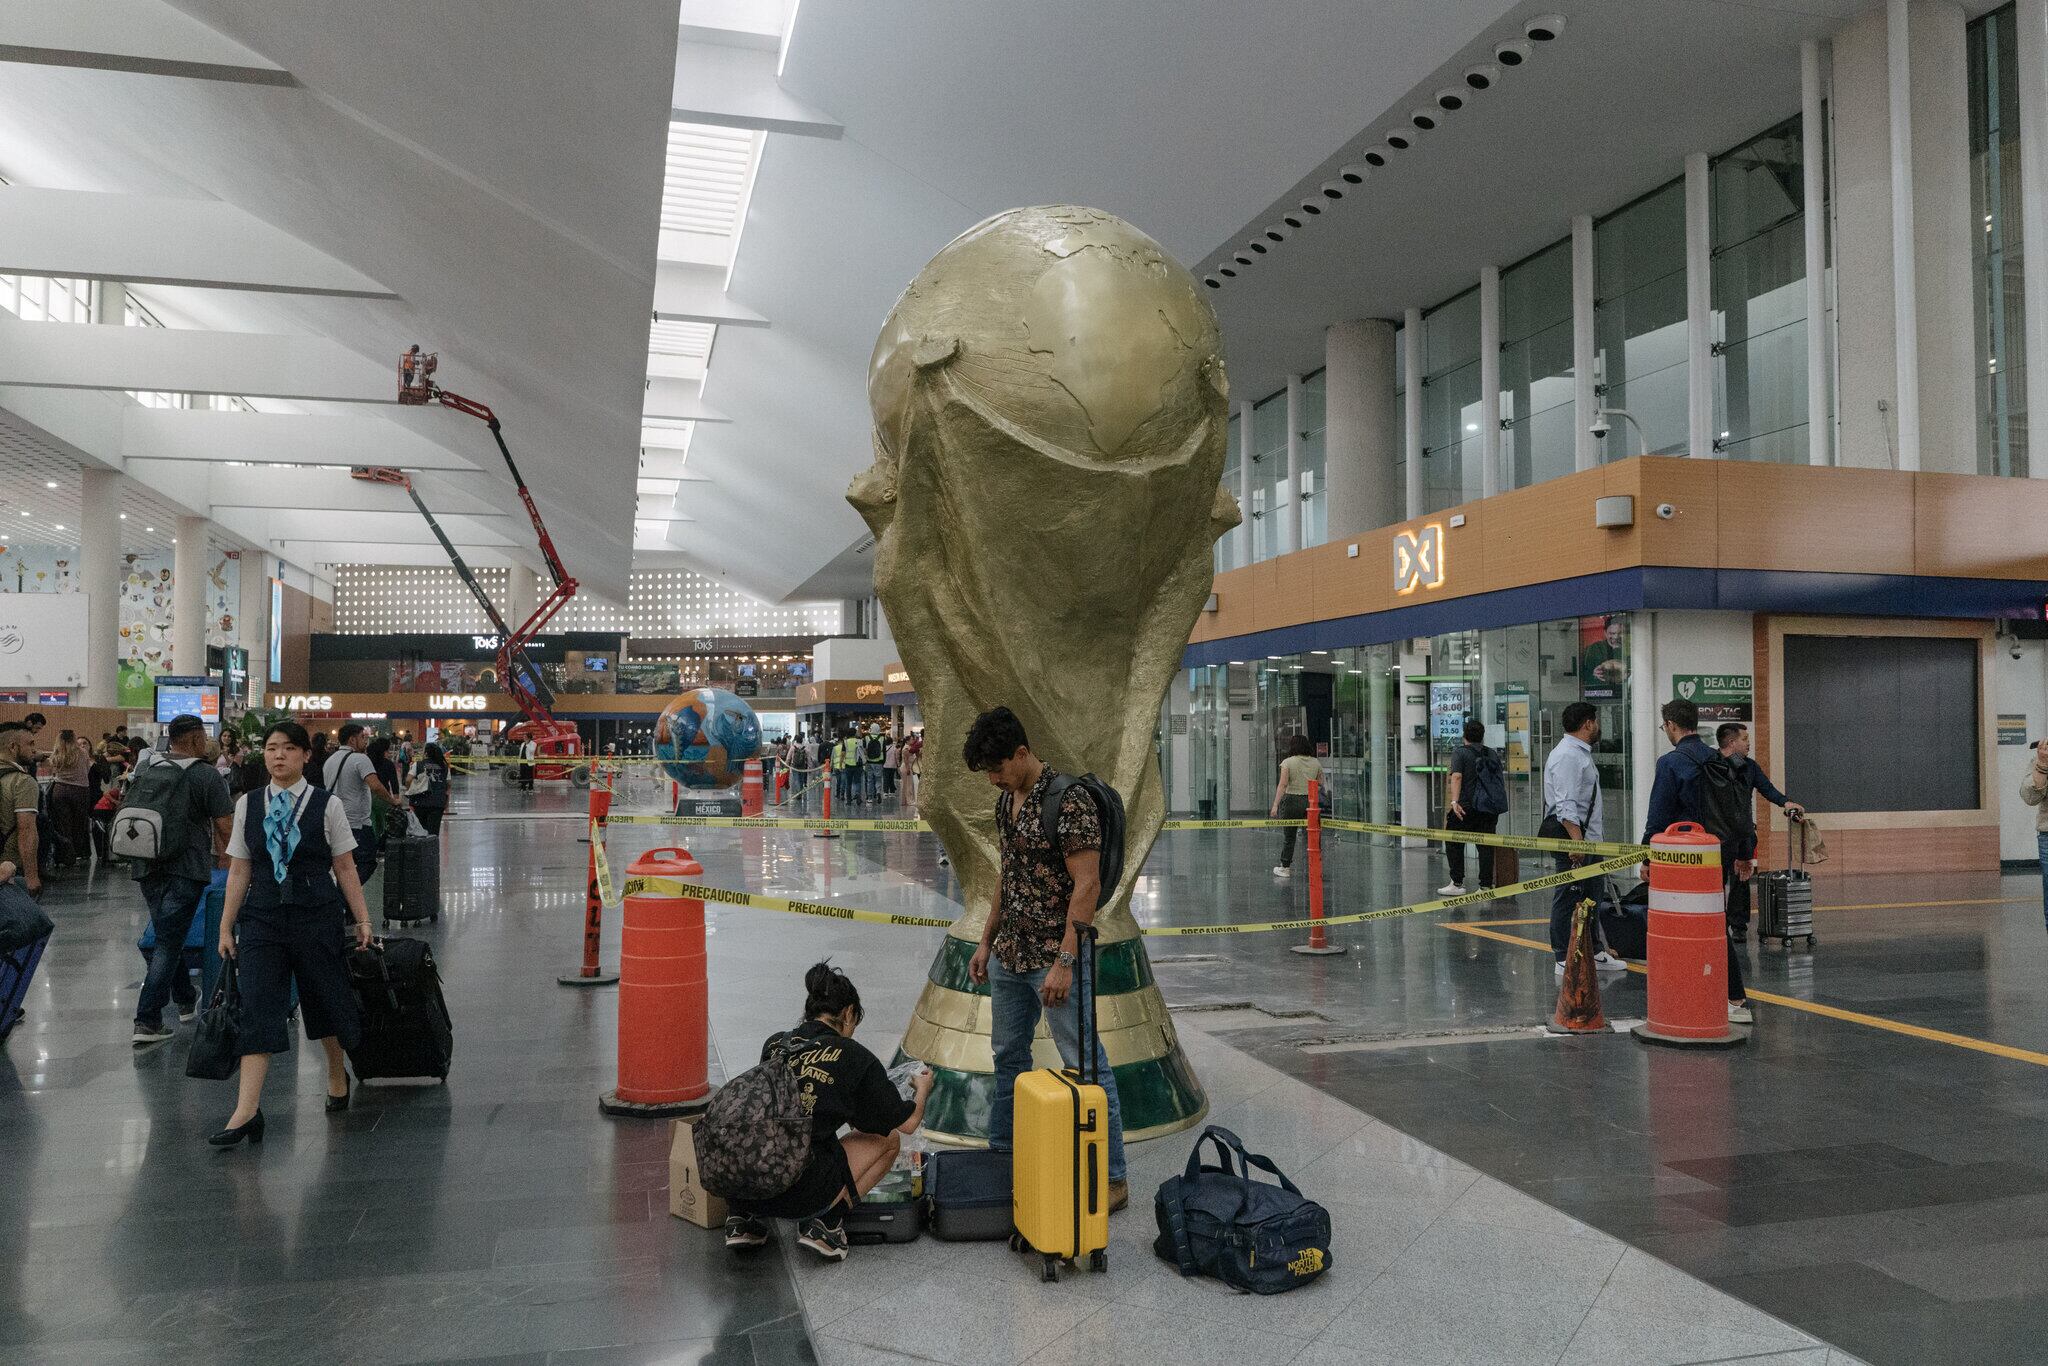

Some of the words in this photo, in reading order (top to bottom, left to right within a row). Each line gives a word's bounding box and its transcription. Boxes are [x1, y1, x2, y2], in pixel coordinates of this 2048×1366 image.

[1703, 677, 1726, 688] DEA
[1729, 677, 1751, 688] AED
[1438, 703, 1463, 712] 18.00
[1440, 727, 1460, 735] 23.50
[1650, 851, 1703, 865] PRECAUCION
[1522, 872, 1576, 891] PRECAUCION
[1599, 852, 1650, 872] PRECAUCION
[681, 883, 751, 906] PRECAUCION
[788, 900, 855, 920] PRECAUCION
[800, 1045, 843, 1066] Wall
[1297, 1247, 1314, 1260] THE
[1287, 1257, 1314, 1272] NORTH
[1294, 1265, 1315, 1277] FACE
